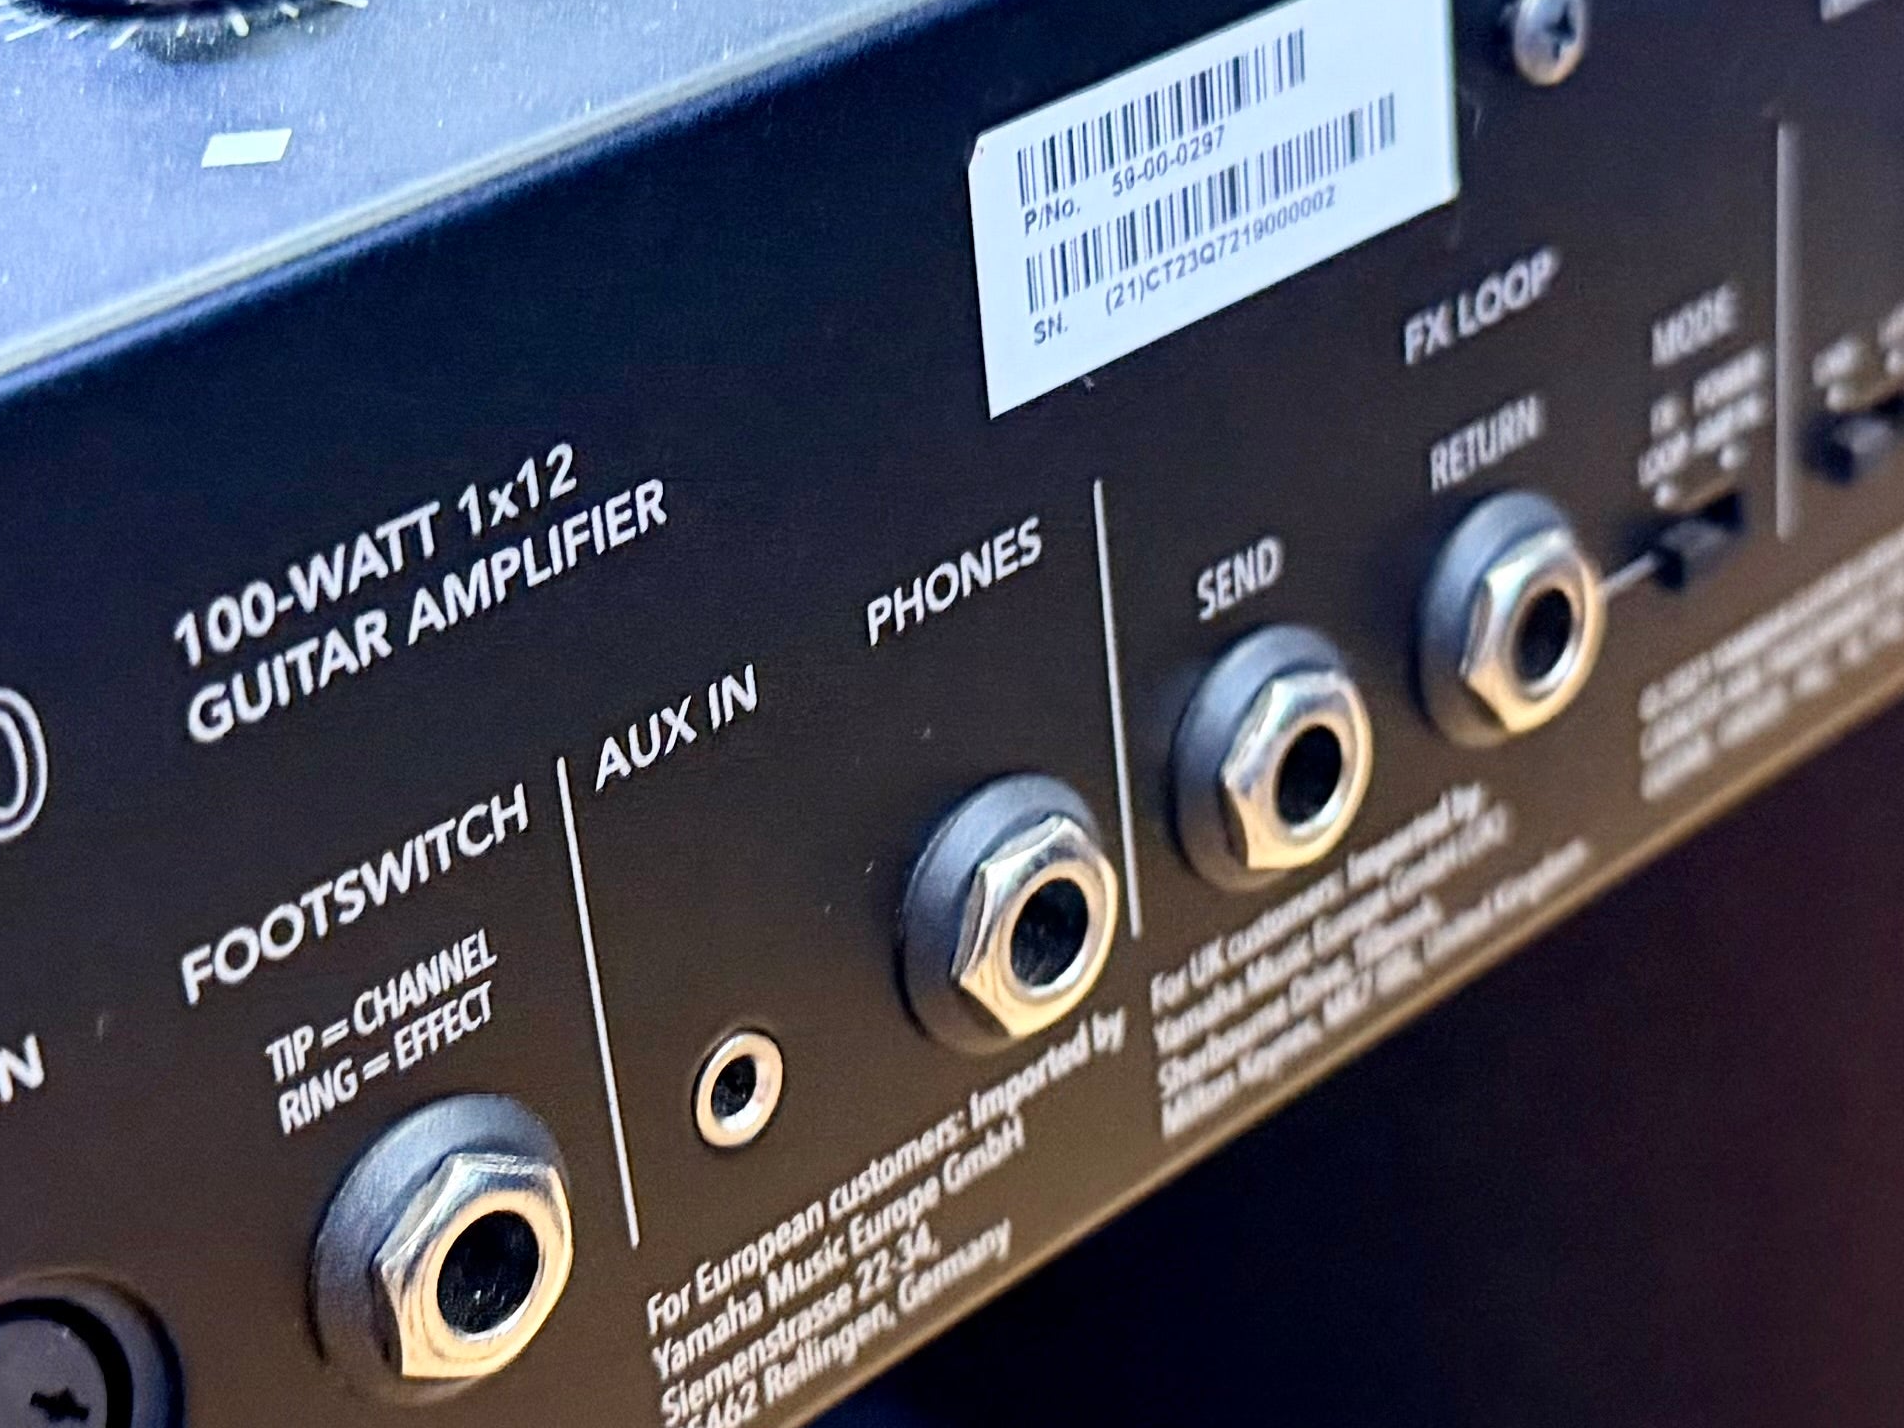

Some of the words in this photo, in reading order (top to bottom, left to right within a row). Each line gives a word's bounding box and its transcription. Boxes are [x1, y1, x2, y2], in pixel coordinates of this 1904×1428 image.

[1023, 199, 1082, 235] P/No.
[1404, 300, 1455, 366] FX
[1457, 245, 1562, 336] LOOP
[1651, 281, 1738, 366] MODE
[1431, 392, 1542, 494] RETURN
[173, 499, 440, 667] 100-WATT
[457, 442, 576, 540] 1x12
[187, 610, 393, 744] GUITAR
[407, 478, 668, 646] AMPLIFIER
[866, 518, 1043, 647] PHONES
[1197, 535, 1284, 622] SEND
[596, 701, 696, 792] AUX
[708, 664, 758, 732] IN
[181, 782, 530, 1005] FOOTSWITCH
[266, 1029, 314, 1083] TIP
[352, 928, 499, 1038] CHANNEL
[279, 1066, 359, 1135] RING
[392, 980, 494, 1073] EFFECT
[645, 1285, 692, 1336] For
[695, 1202, 824, 1306] European
[828, 1122, 967, 1223] customers:
[969, 1020, 1090, 1121] Imported
[1092, 1007, 1127, 1052] by
[652, 1290, 764, 1381] Yamaha
[767, 1234, 846, 1312] Music
[849, 1175, 941, 1256] Europe
[943, 1115, 1026, 1195] GmbH
[898, 1218, 1012, 1317] Germany
[661, 1284, 854, 1427] Siemenstrasse
